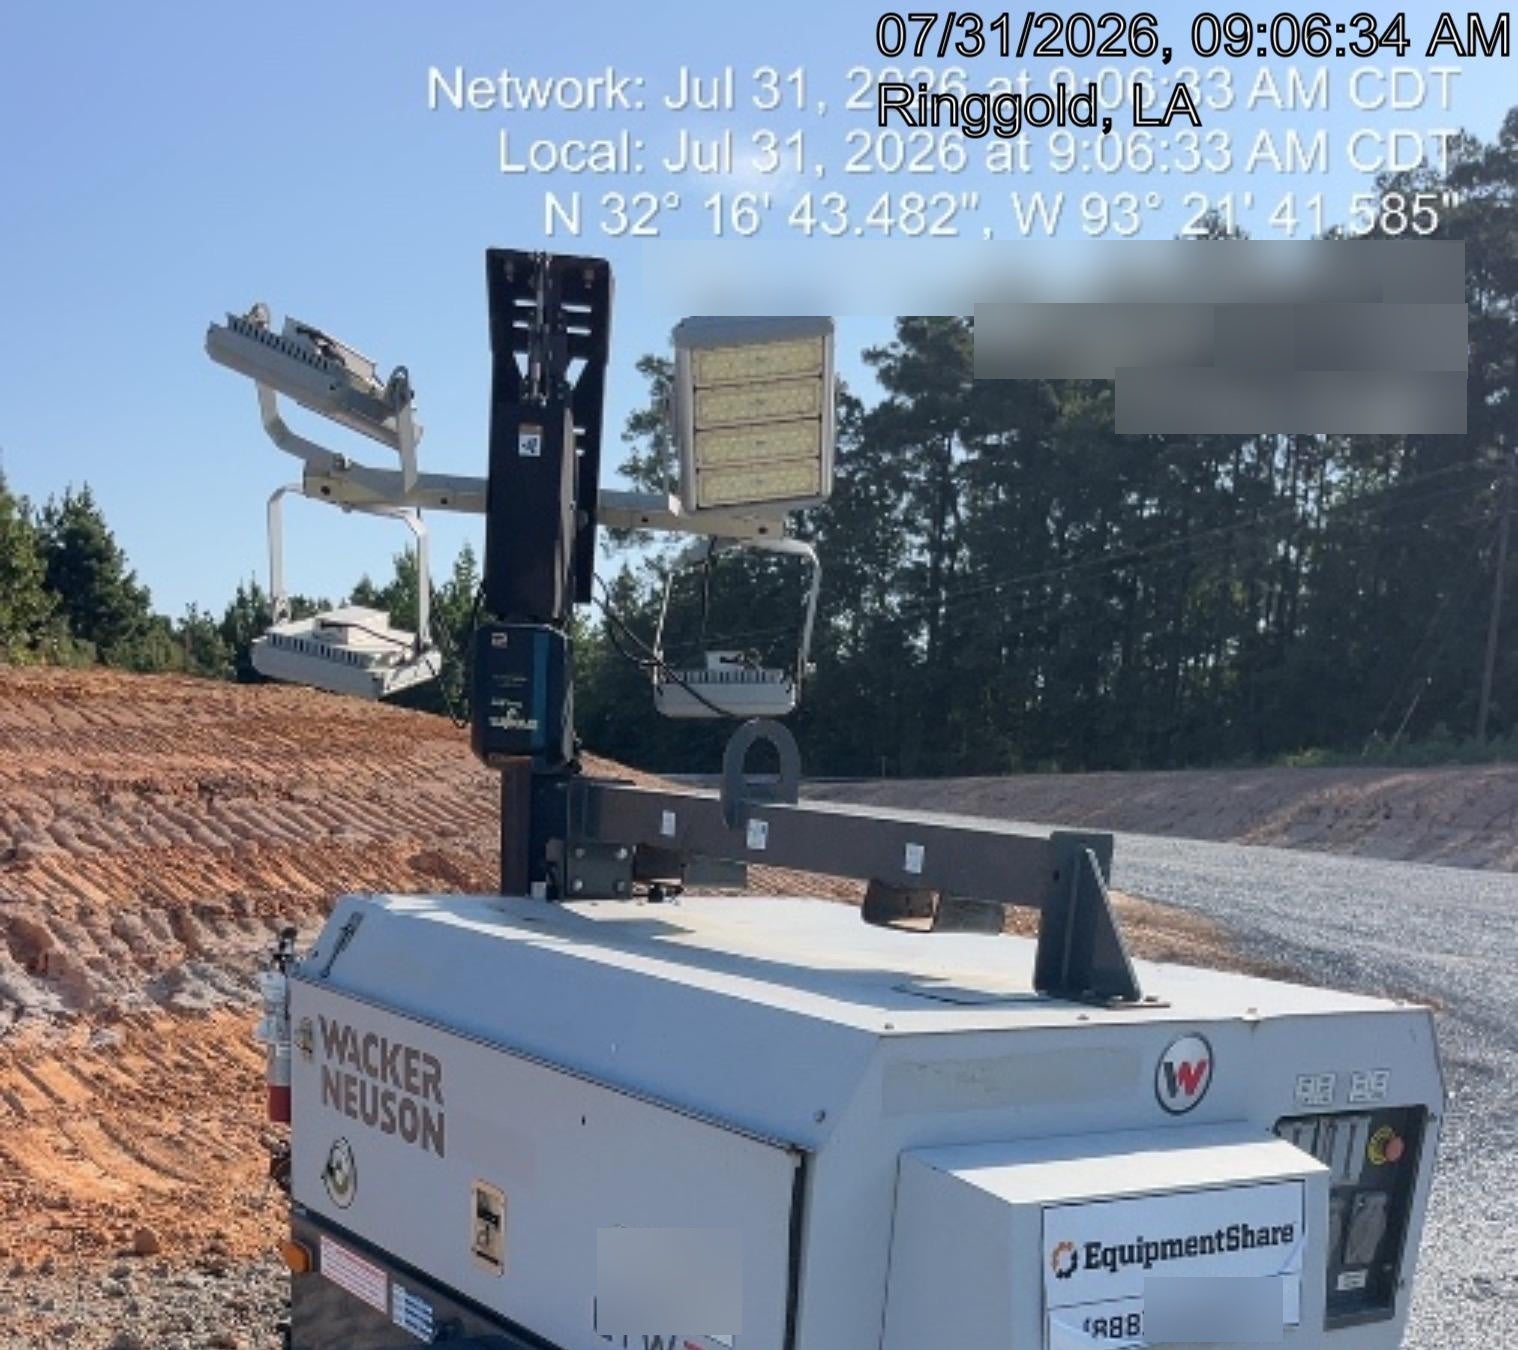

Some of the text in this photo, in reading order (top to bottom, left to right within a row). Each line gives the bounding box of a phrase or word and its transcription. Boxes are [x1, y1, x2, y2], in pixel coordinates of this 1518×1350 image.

[318, 1014, 444, 1105] WACKER
[320, 1064, 445, 1158] NEUSON
[1083, 1223, 1295, 1273] EquipmentShare
